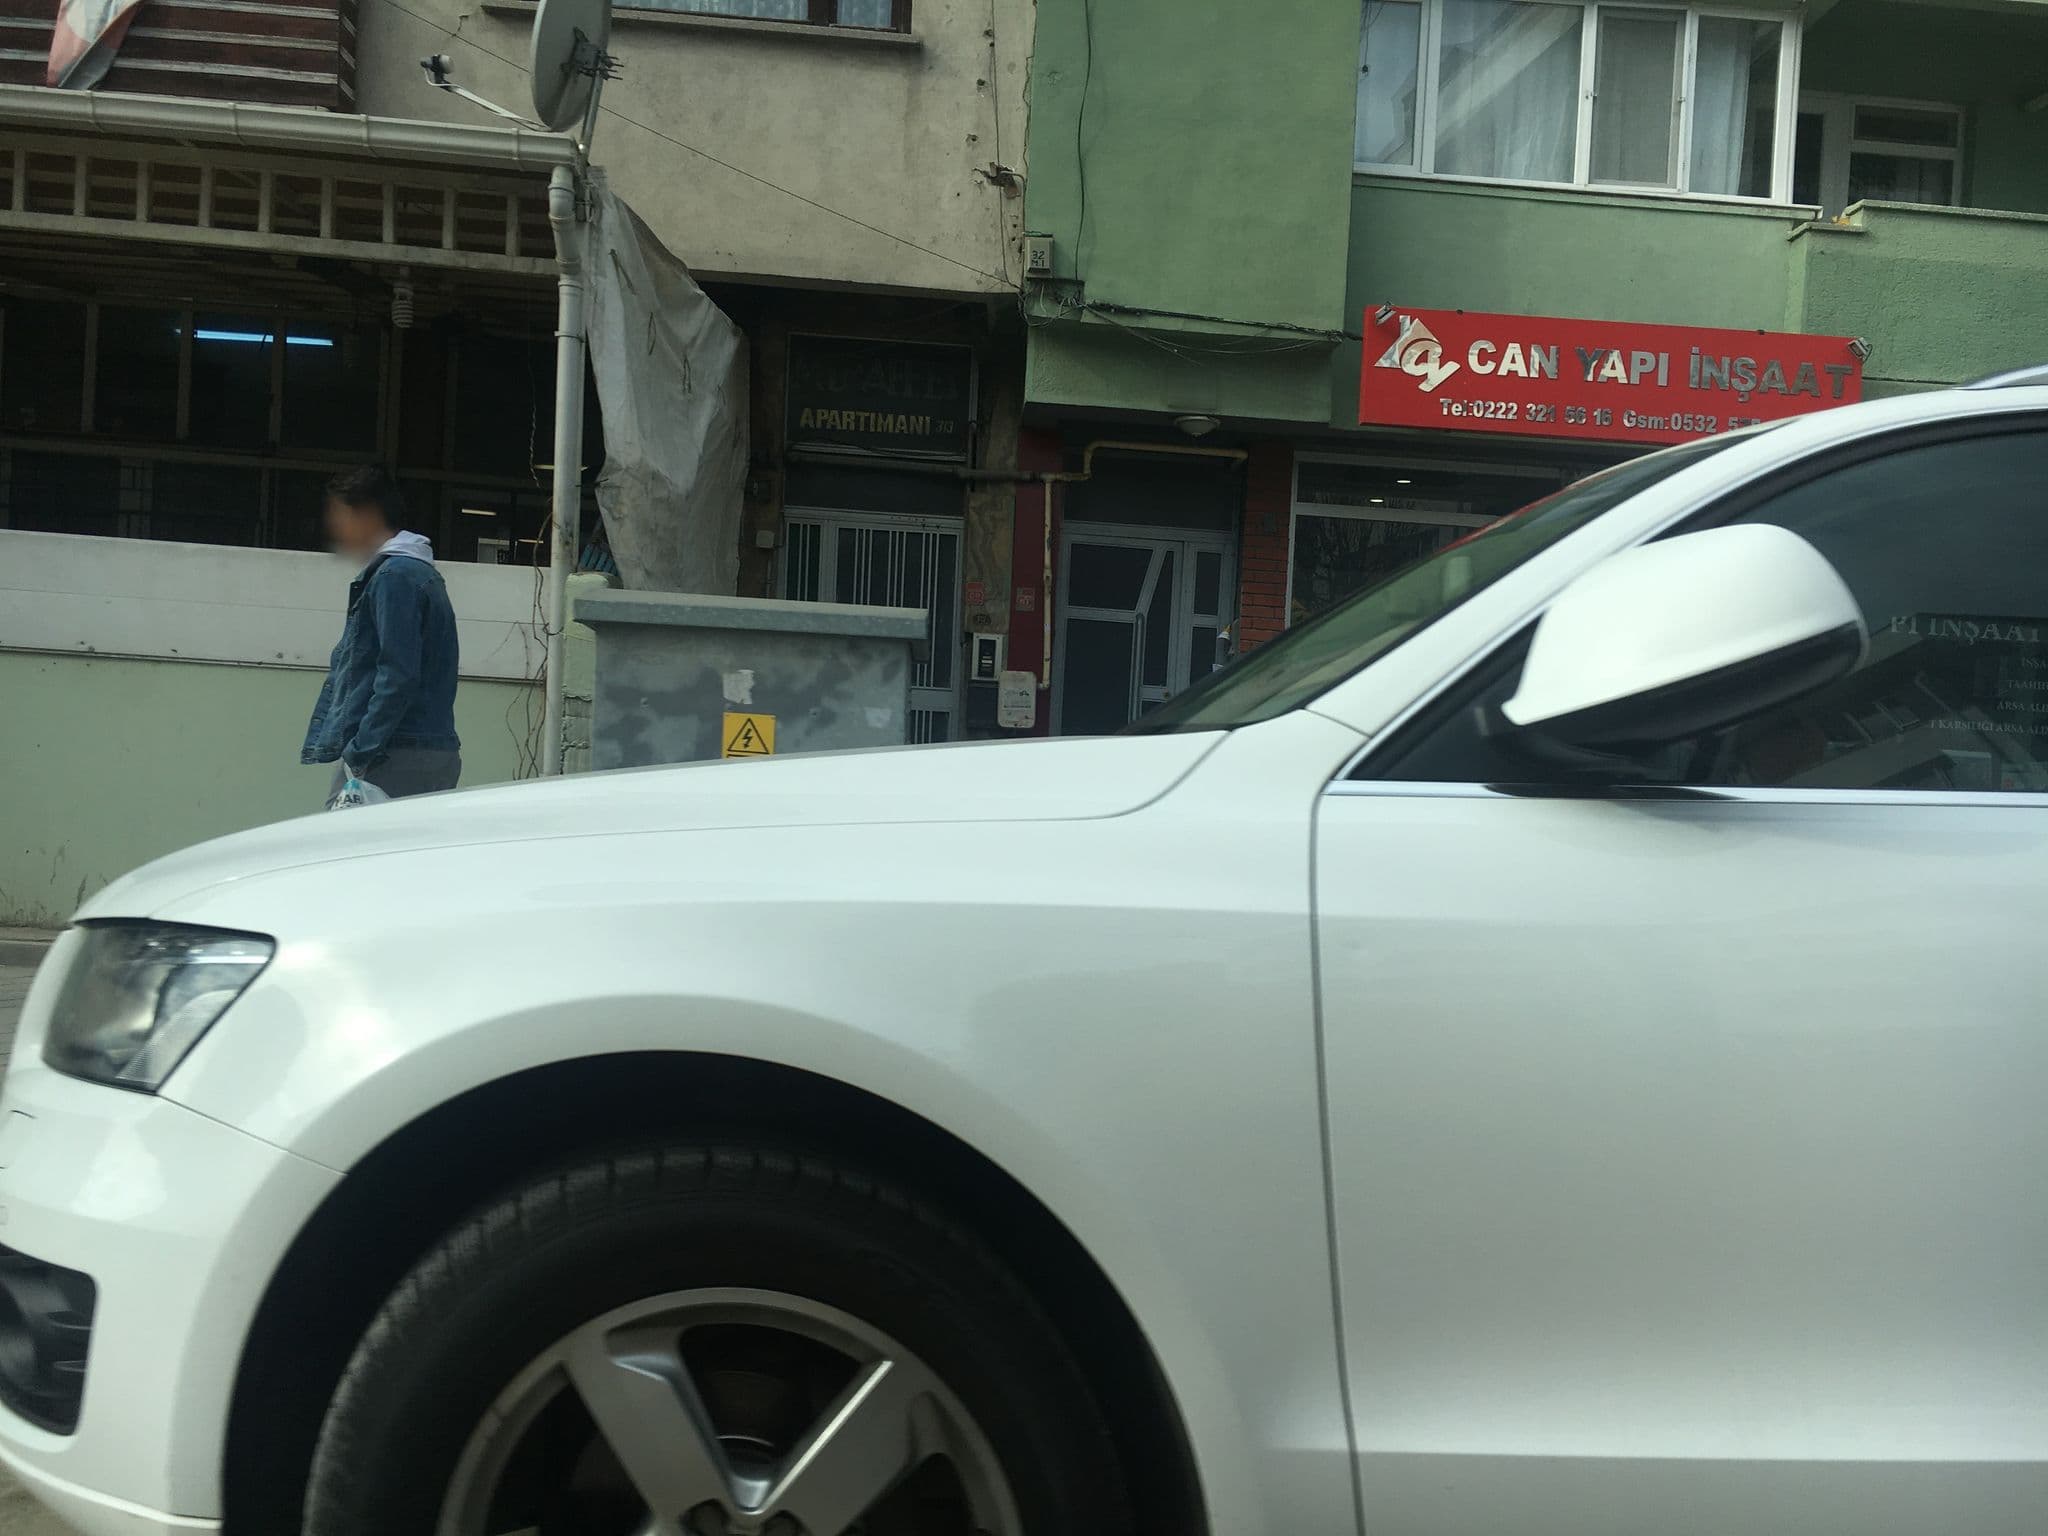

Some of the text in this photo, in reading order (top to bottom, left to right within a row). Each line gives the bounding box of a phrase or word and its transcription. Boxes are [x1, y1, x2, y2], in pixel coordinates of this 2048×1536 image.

[1032, 250, 1045, 259] 32
[1467, 339, 1853, 402] CAN YAPI İNŞAAT
[800, 408, 930, 435] APARTIMANI
[1439, 398, 1518, 420] Tel:0222
[1526, 403, 1556, 423] 321
[1622, 409, 1717, 434] Gsm:0532
